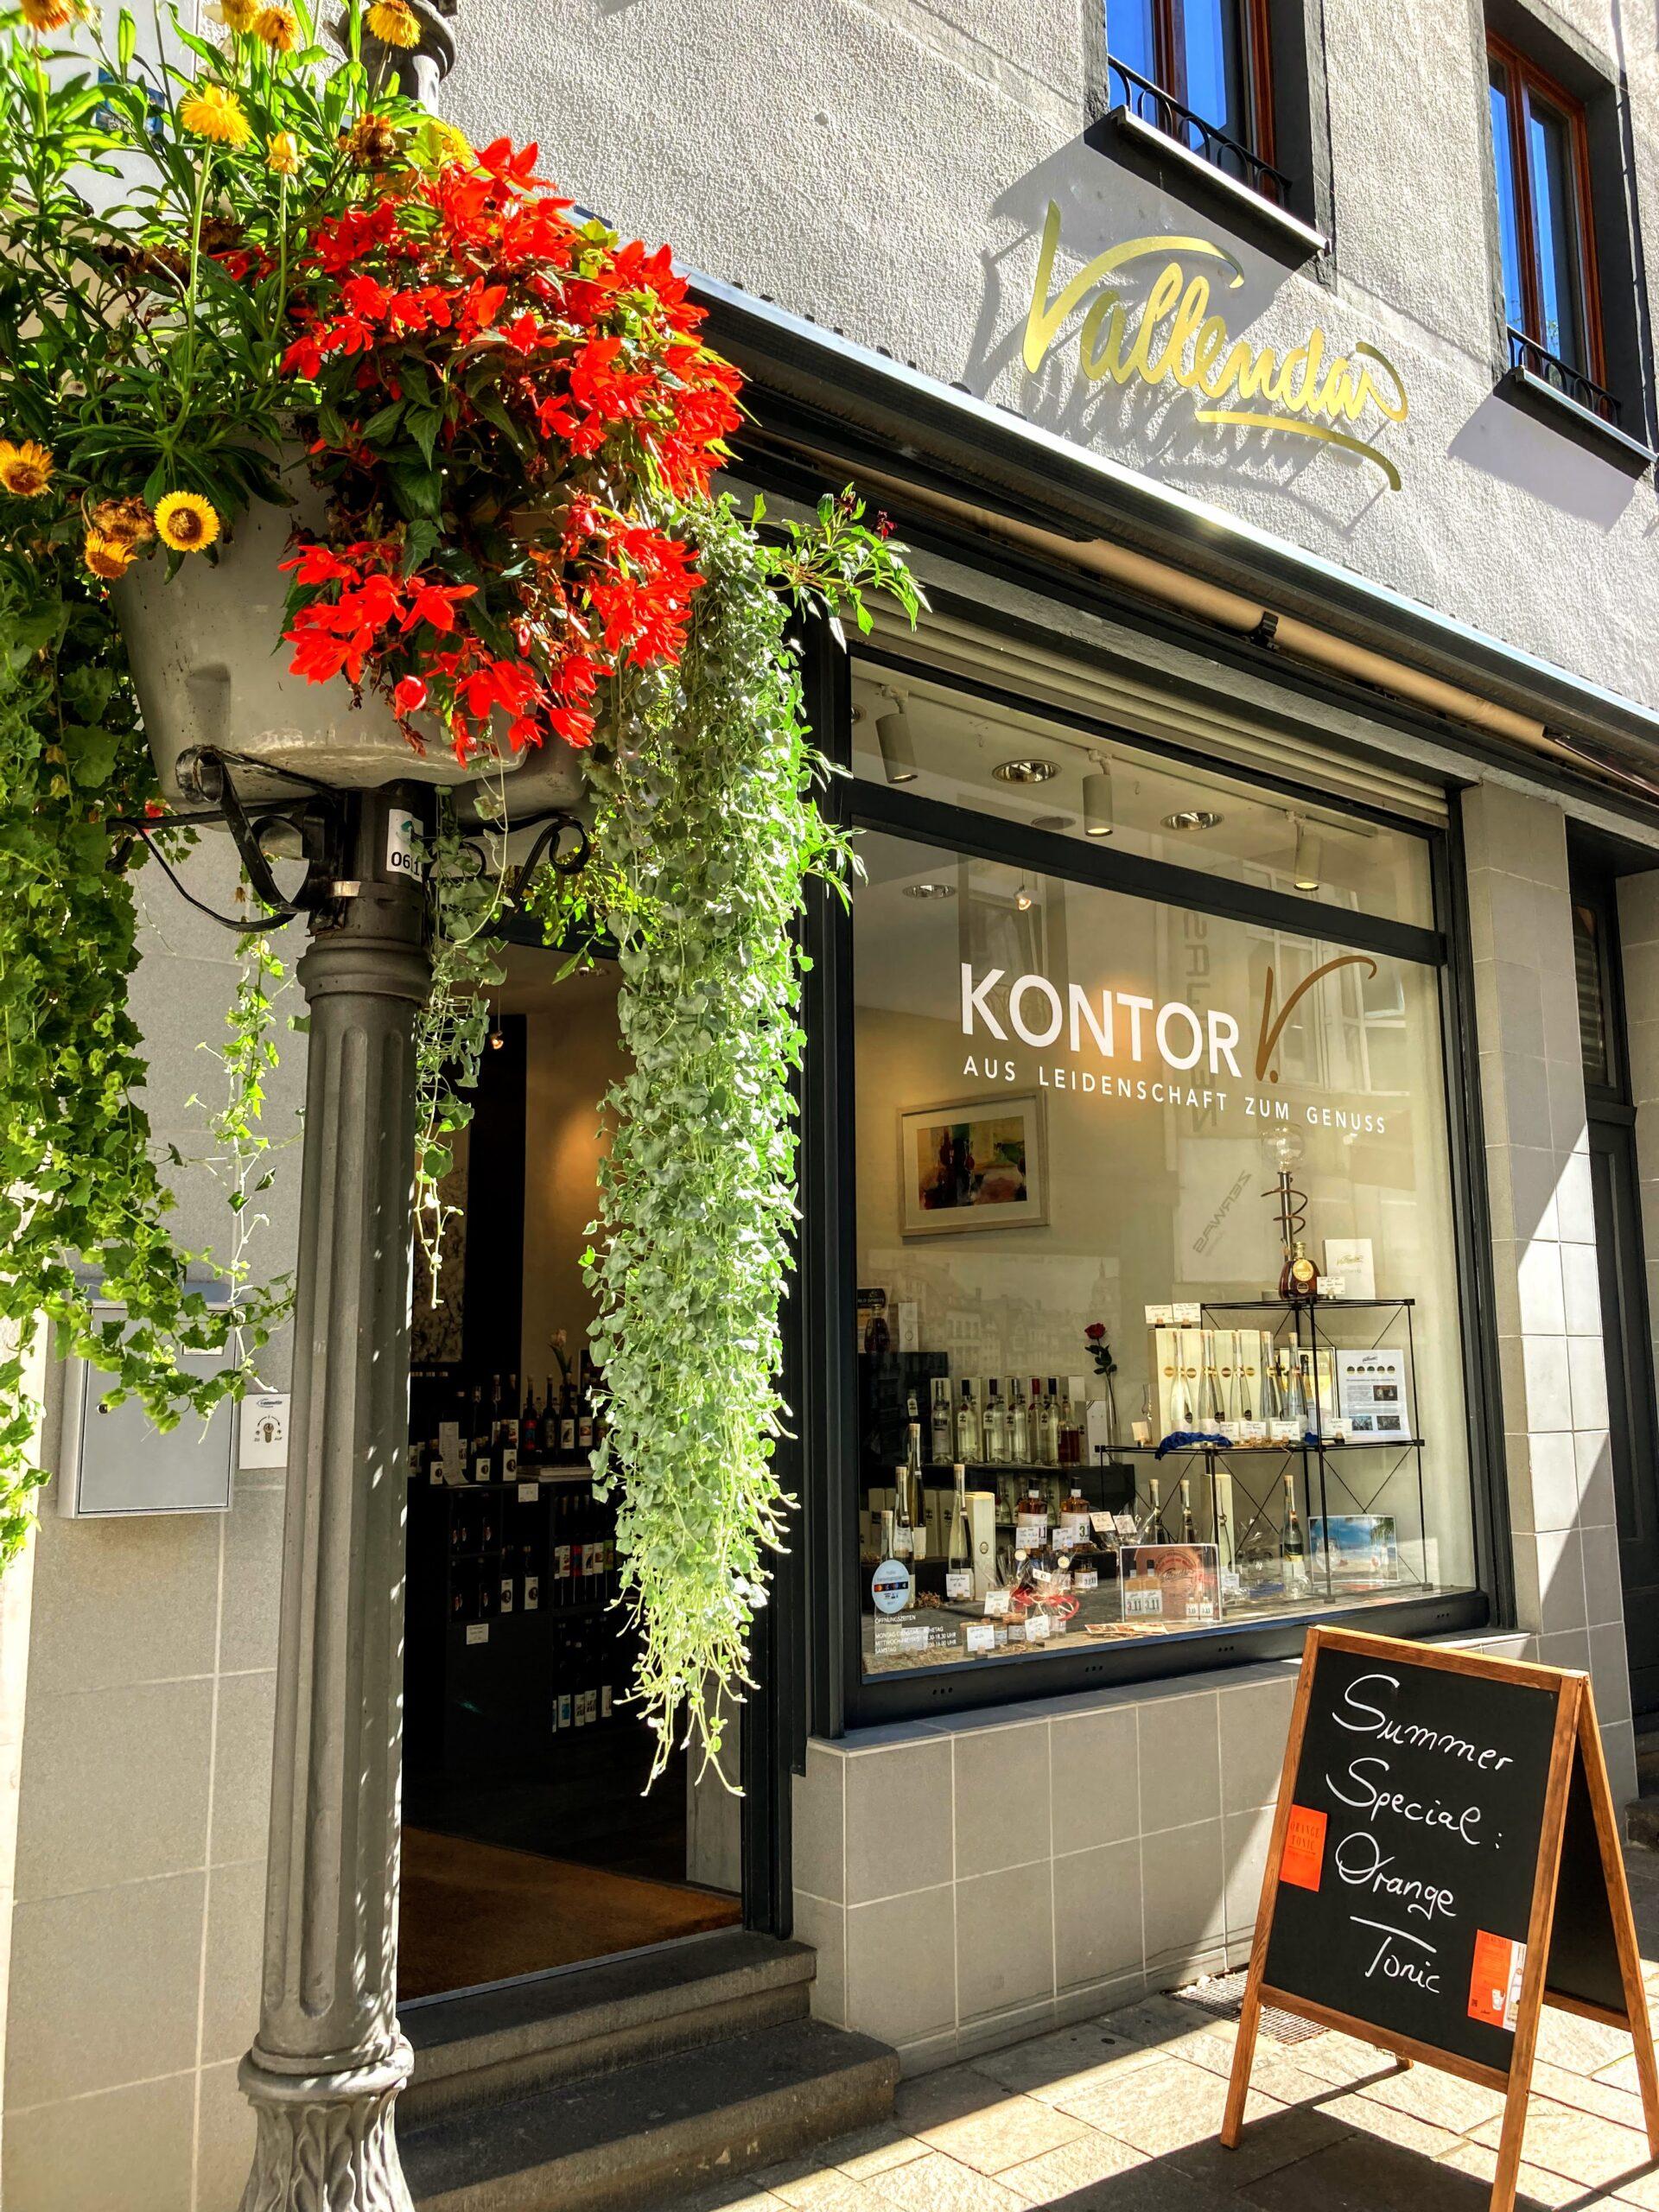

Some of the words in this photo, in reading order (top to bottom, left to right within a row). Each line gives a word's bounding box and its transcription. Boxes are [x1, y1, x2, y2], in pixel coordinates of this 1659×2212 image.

[1022, 199, 1409, 423] Vallendar
[961, 962, 1243, 1078] KONTOR
[963, 1055, 1016, 1082] AUS
[1039, 1065, 1228, 1112] LEIDENSCHAFT
[1244, 1096, 1291, 1121] ZUM
[1306, 1107, 1385, 1135] GENUSS
[1332, 1674, 1514, 1771] Summer
[1290, 1821, 1319, 1839] ORANGE
[1292, 1834, 1315, 1851] TONIC
[1335, 1831, 1457, 1920] Orange
[1350, 1915, 1440, 1993] Tonic
